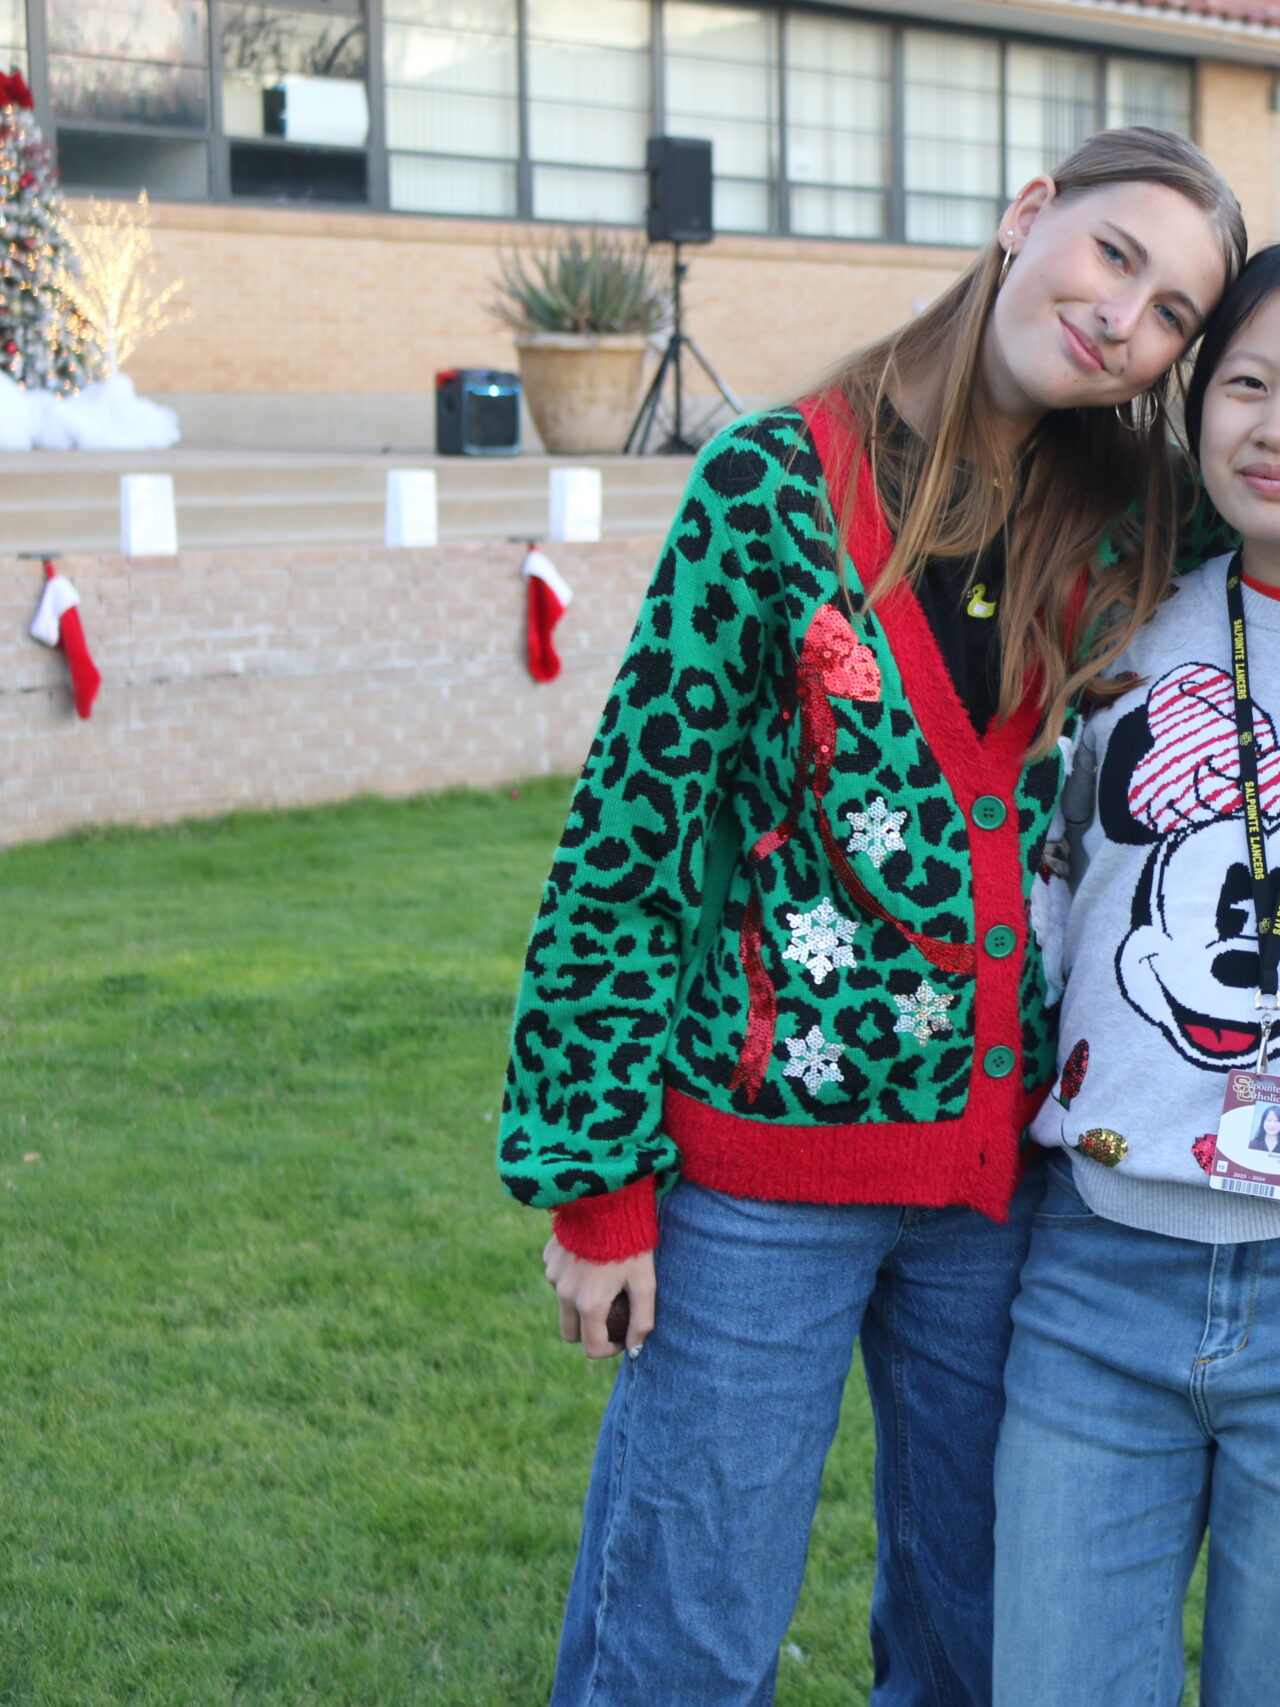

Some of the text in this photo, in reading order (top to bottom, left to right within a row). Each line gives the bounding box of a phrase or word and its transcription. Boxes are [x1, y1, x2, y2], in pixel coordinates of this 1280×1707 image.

[1234, 619, 1247, 700] SALPOINTE LANCERS
[1245, 781, 1265, 880] SALPOINTE LANCERS
